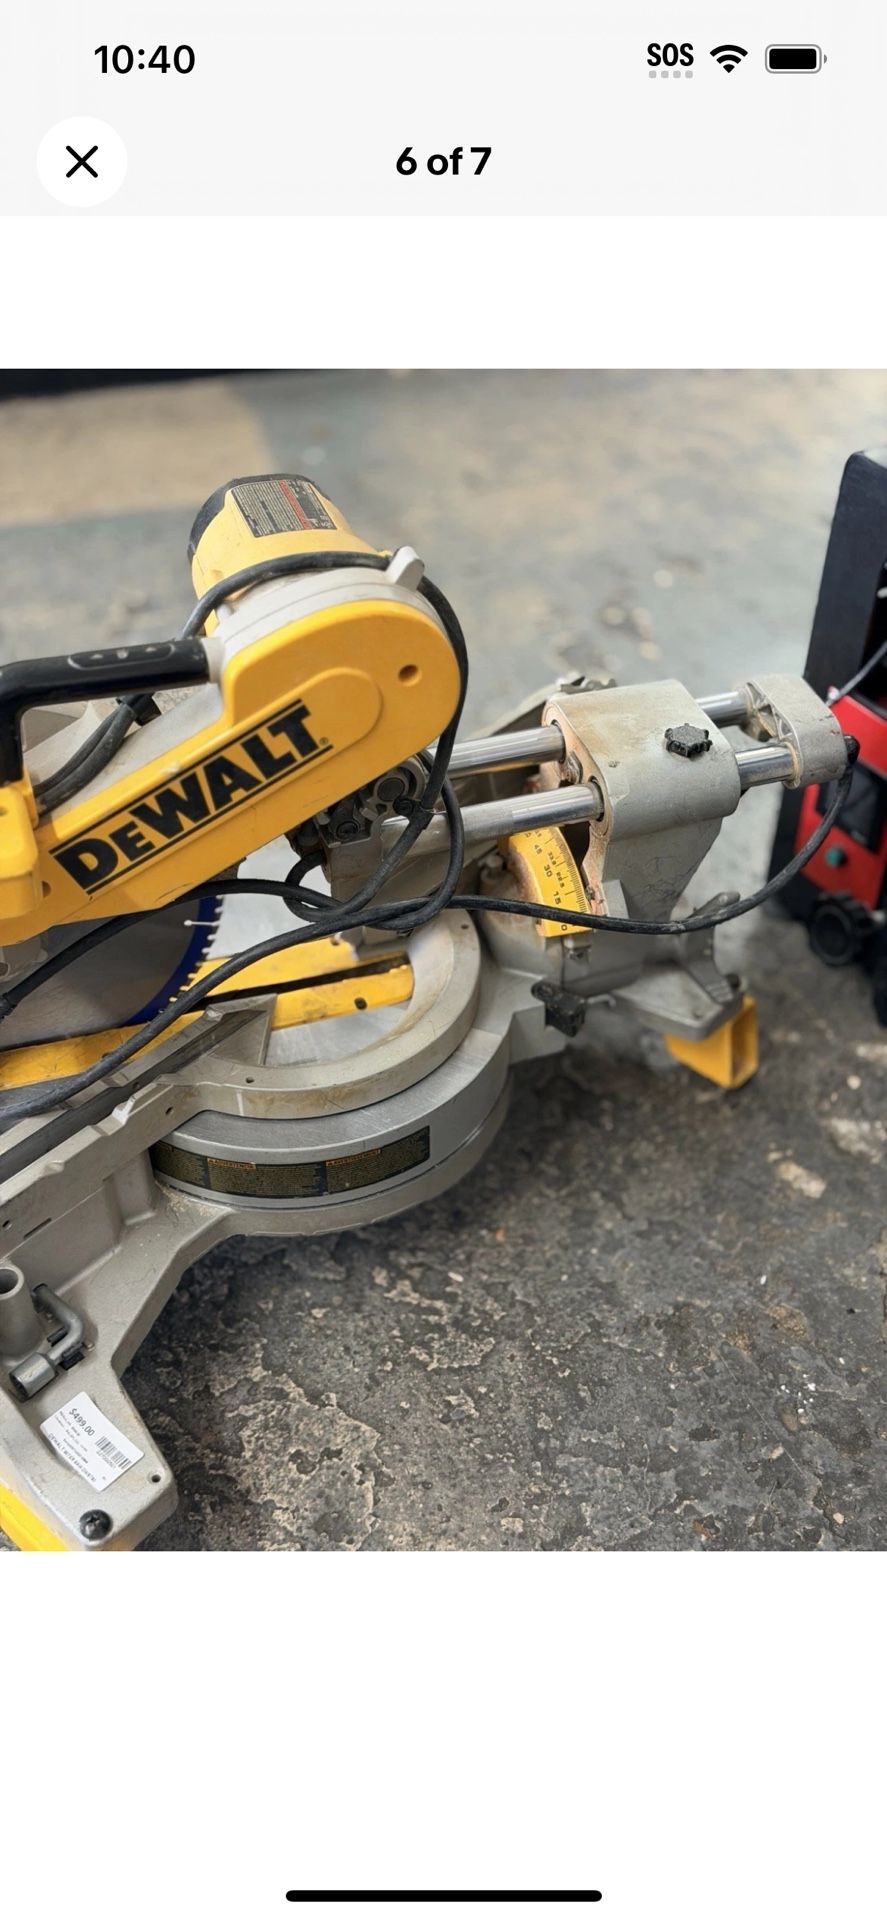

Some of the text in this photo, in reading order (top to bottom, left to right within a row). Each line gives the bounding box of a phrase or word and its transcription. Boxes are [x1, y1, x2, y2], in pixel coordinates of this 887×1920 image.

[53, 704, 319, 890] DEWALT
[543, 864, 553, 878] 30
[553, 891, 562, 905] 15
[68, 1408, 95, 1437] $499.00
